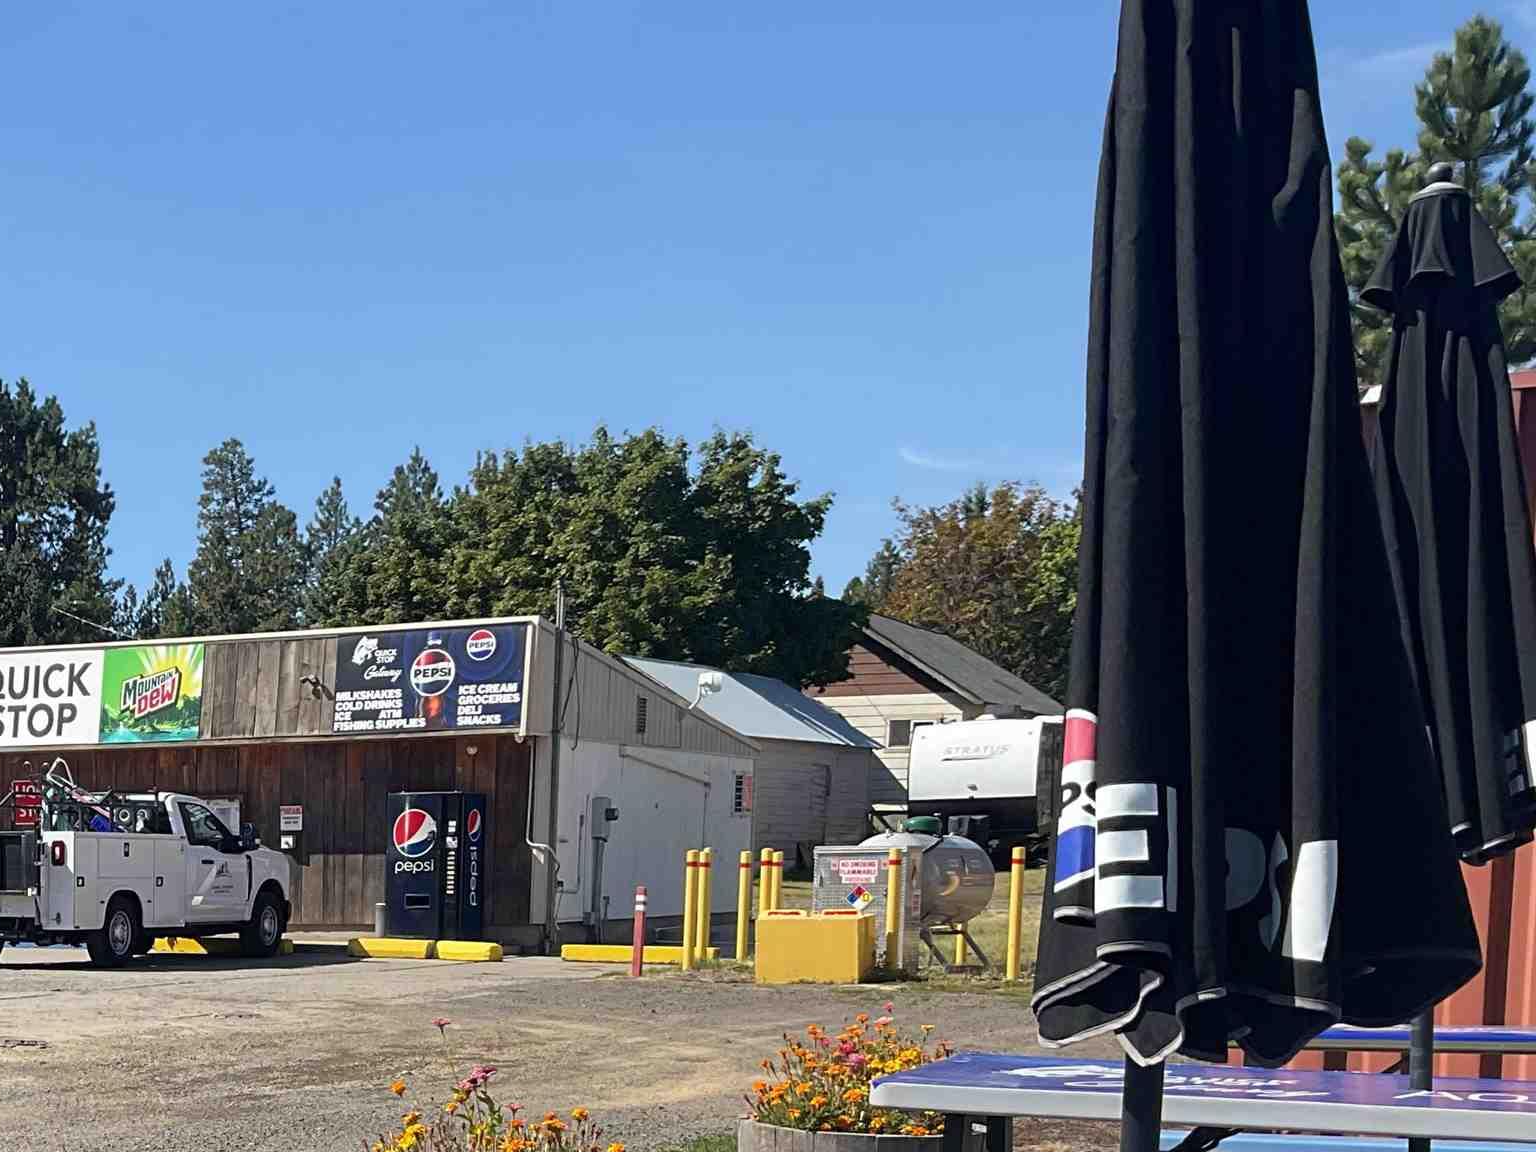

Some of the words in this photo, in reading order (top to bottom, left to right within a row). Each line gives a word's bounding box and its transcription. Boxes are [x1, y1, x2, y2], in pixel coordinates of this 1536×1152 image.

[374, 649, 397, 657] QUICK
[414, 666, 452, 678] PEPSI
[458, 685, 476, 694] ICE
[477, 683, 518, 693] CREAM
[336, 689, 402, 701] MILKSHAKES
[458, 693, 520, 704] GROCERIES
[336, 701, 363, 711] COLD
[364, 699, 403, 709] DRINKS
[457, 705, 482, 715] DELI
[335, 711, 351, 721] ICE
[379, 709, 402, 719] ATM
[456, 714, 501, 726] SNACKS
[334, 720, 374, 731] FISHING
[375, 718, 426, 730] SUPPLIES
[944, 744, 1008, 755] STRATUS
[394, 859, 434, 874] pepsi
[469, 846, 478, 906] pepsi
